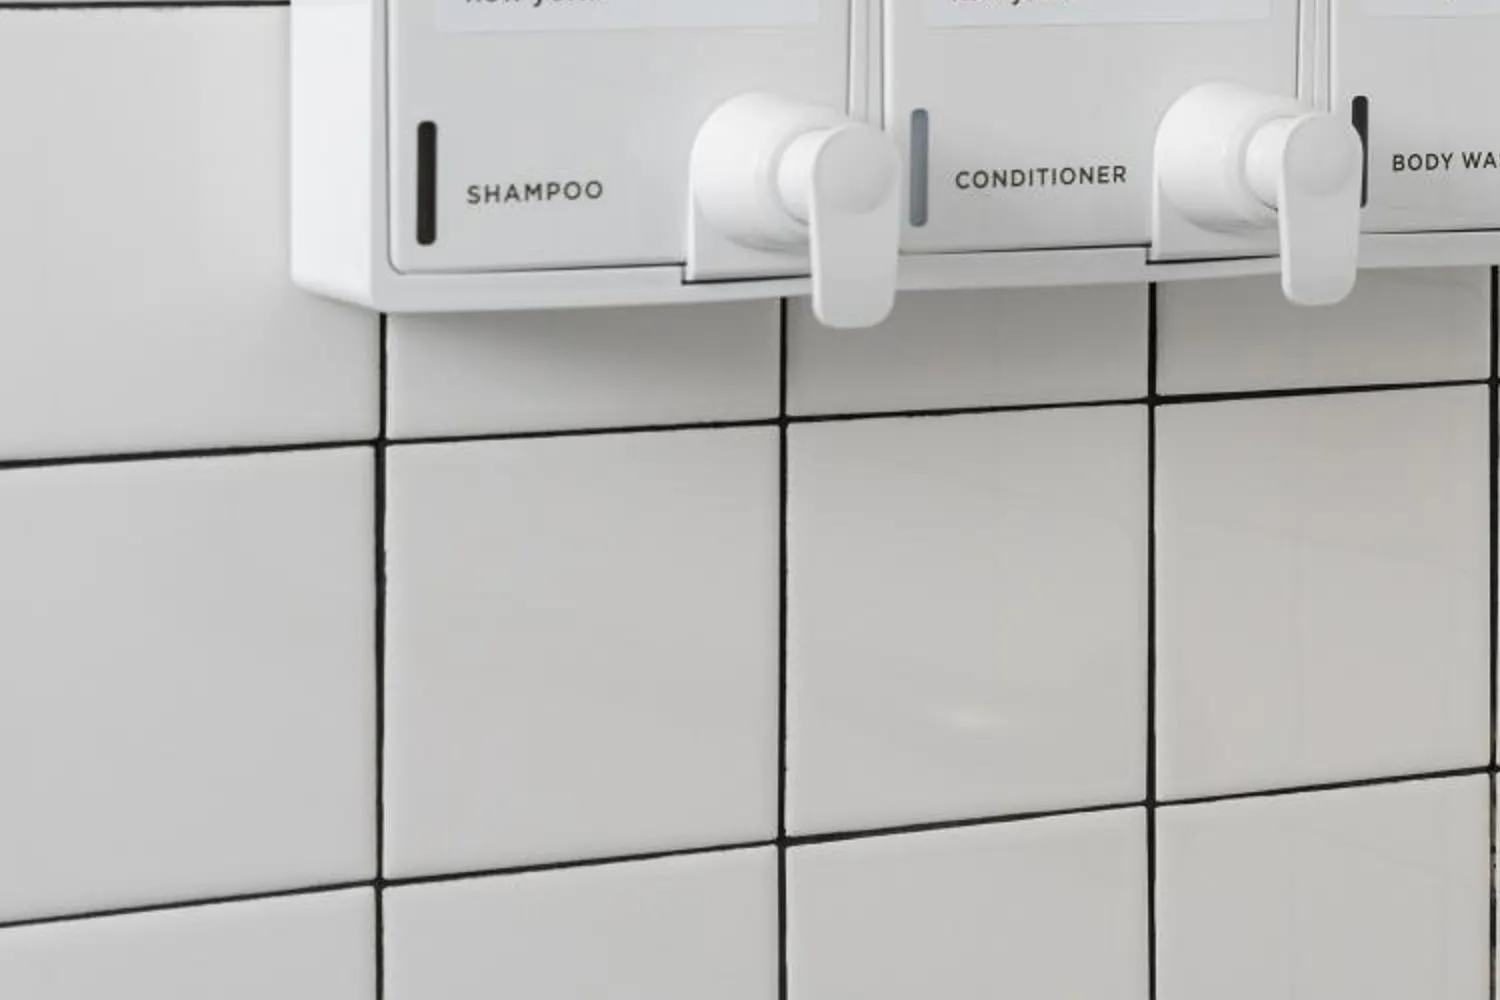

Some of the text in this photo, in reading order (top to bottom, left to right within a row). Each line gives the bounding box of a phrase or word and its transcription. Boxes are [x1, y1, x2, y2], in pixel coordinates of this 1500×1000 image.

[1391, 152, 1454, 172] BODY
[955, 165, 1127, 190] CONDITIONER
[466, 179, 604, 206] SHAMPOO
